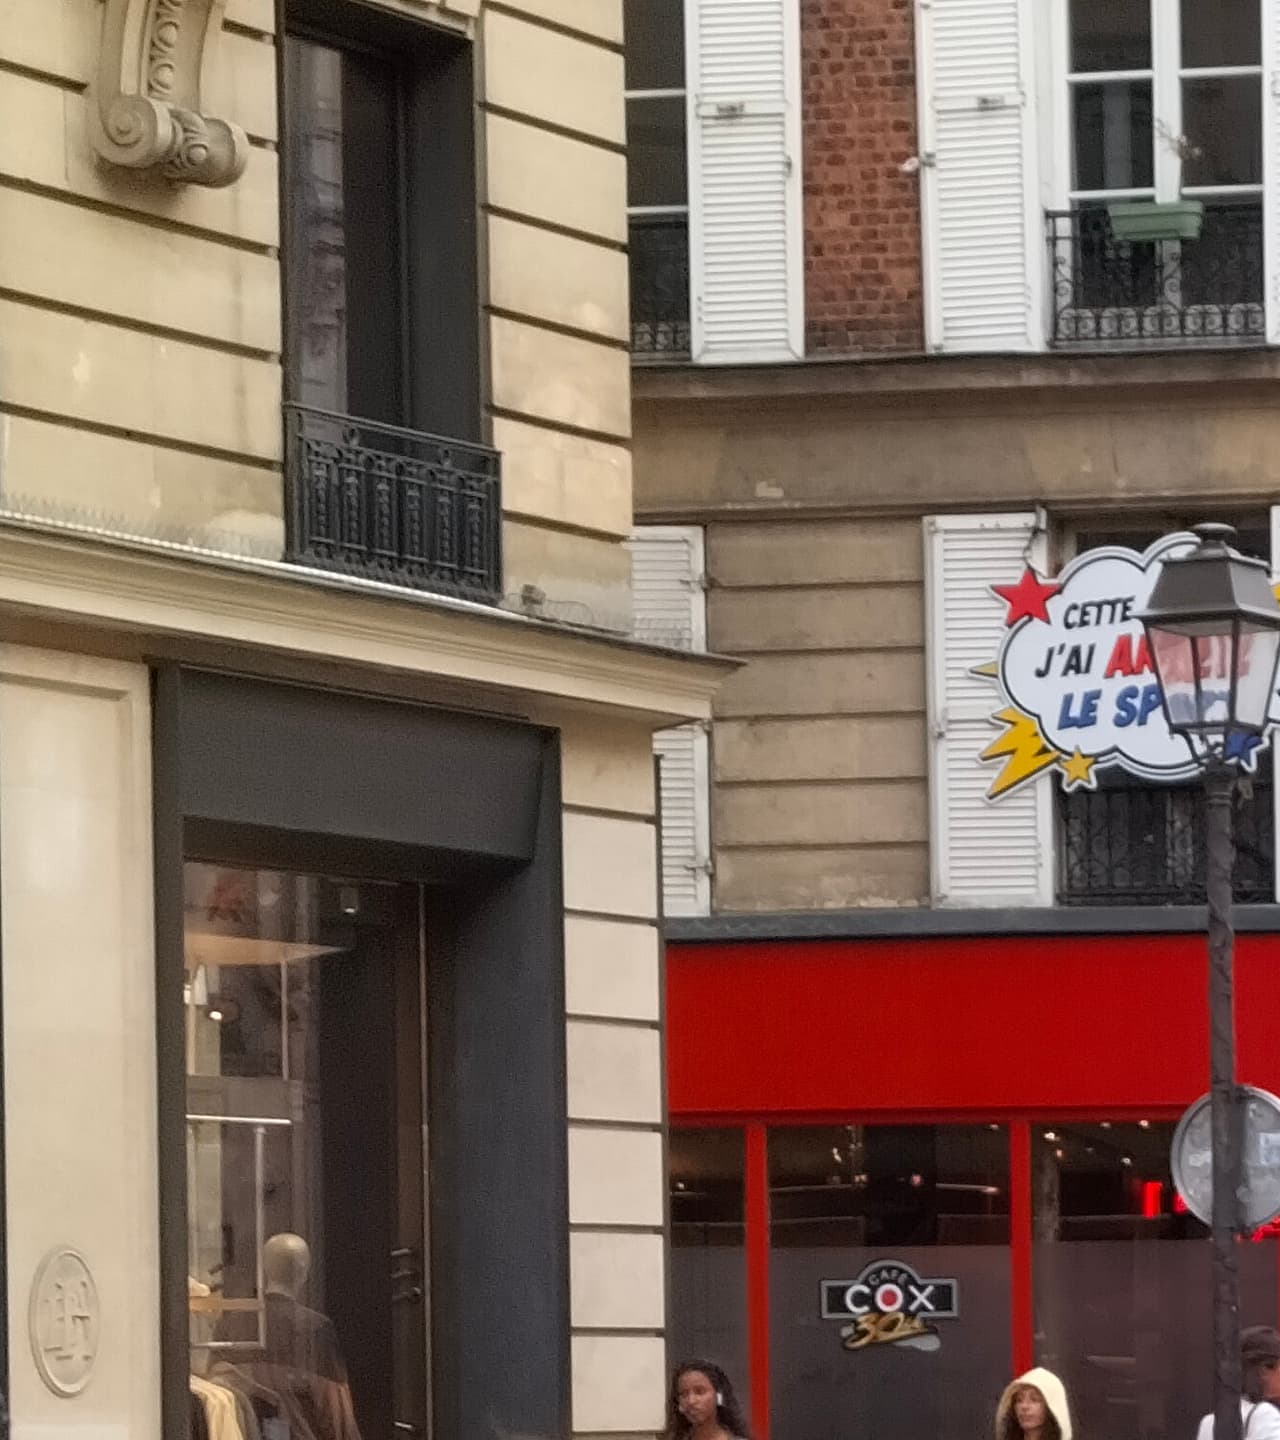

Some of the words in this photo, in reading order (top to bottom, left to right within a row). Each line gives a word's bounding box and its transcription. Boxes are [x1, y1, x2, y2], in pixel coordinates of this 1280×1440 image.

[1063, 595, 1136, 630] CETTE
[1034, 642, 1097, 678] J'AI
[1057, 690, 1102, 730] LE
[845, 1283, 936, 1314] COX
